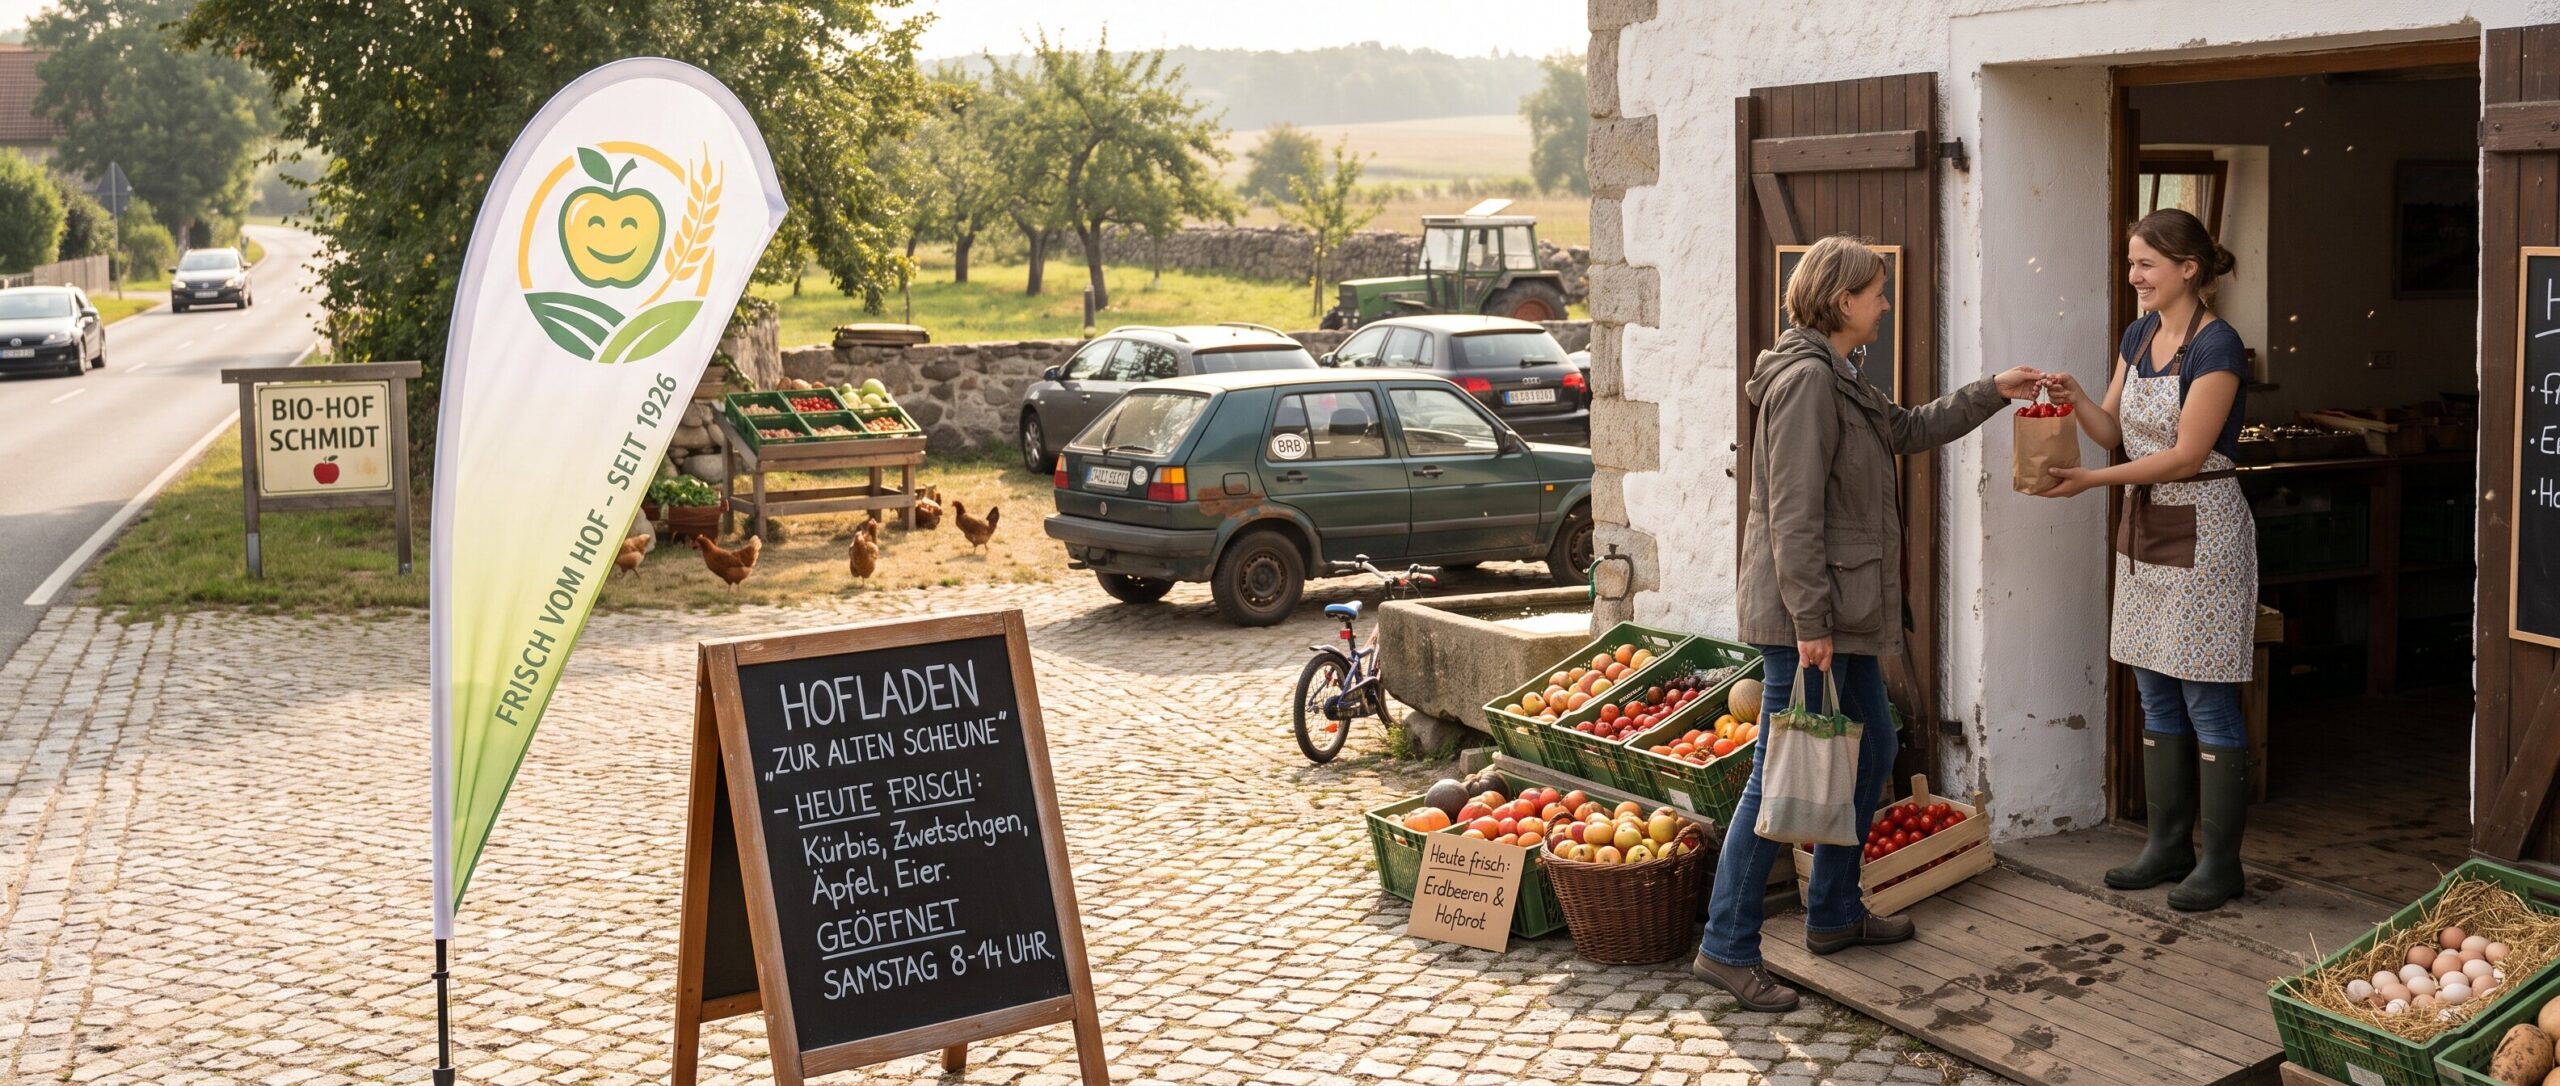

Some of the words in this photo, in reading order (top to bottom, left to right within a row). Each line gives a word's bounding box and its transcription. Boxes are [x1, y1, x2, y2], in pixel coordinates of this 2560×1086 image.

[273, 396, 374, 420] BIO-HOF
[270, 426, 380, 451] SCHMIDT
[1278, 439, 1302, 453] BRB
[495, 629, 556, 727] FRISCH
[540, 565, 586, 626] VOM
[570, 508, 610, 566] HOF
[607, 432, 648, 491] SEIT
[636, 372, 678, 430] 1926
[780, 660, 979, 730] HOFLADEN
[828, 732, 895, 767] ALTEN
[795, 783, 878, 822] HEUTE
[887, 768, 983, 806] FRISCH:
[803, 831, 888, 866] Kürbis,
[890, 811, 1028, 851] Zwetschgen,
[1430, 844, 1466, 867] Heute
[1469, 851, 1510, 876] frisch:
[813, 864, 889, 909] Äpfel,
[895, 859, 950, 889] Eier.
[1424, 876, 1488, 903] Erdbeeren
[1493, 886, 1504, 907] &
[817, 899, 960, 952] GEÖFFNET
[1435, 904, 1487, 931] Hofbrot
[824, 952, 938, 1000] SAMSTAG
[951, 938, 1003, 975] 8-14
[1007, 931, 1056, 964] UHR.
